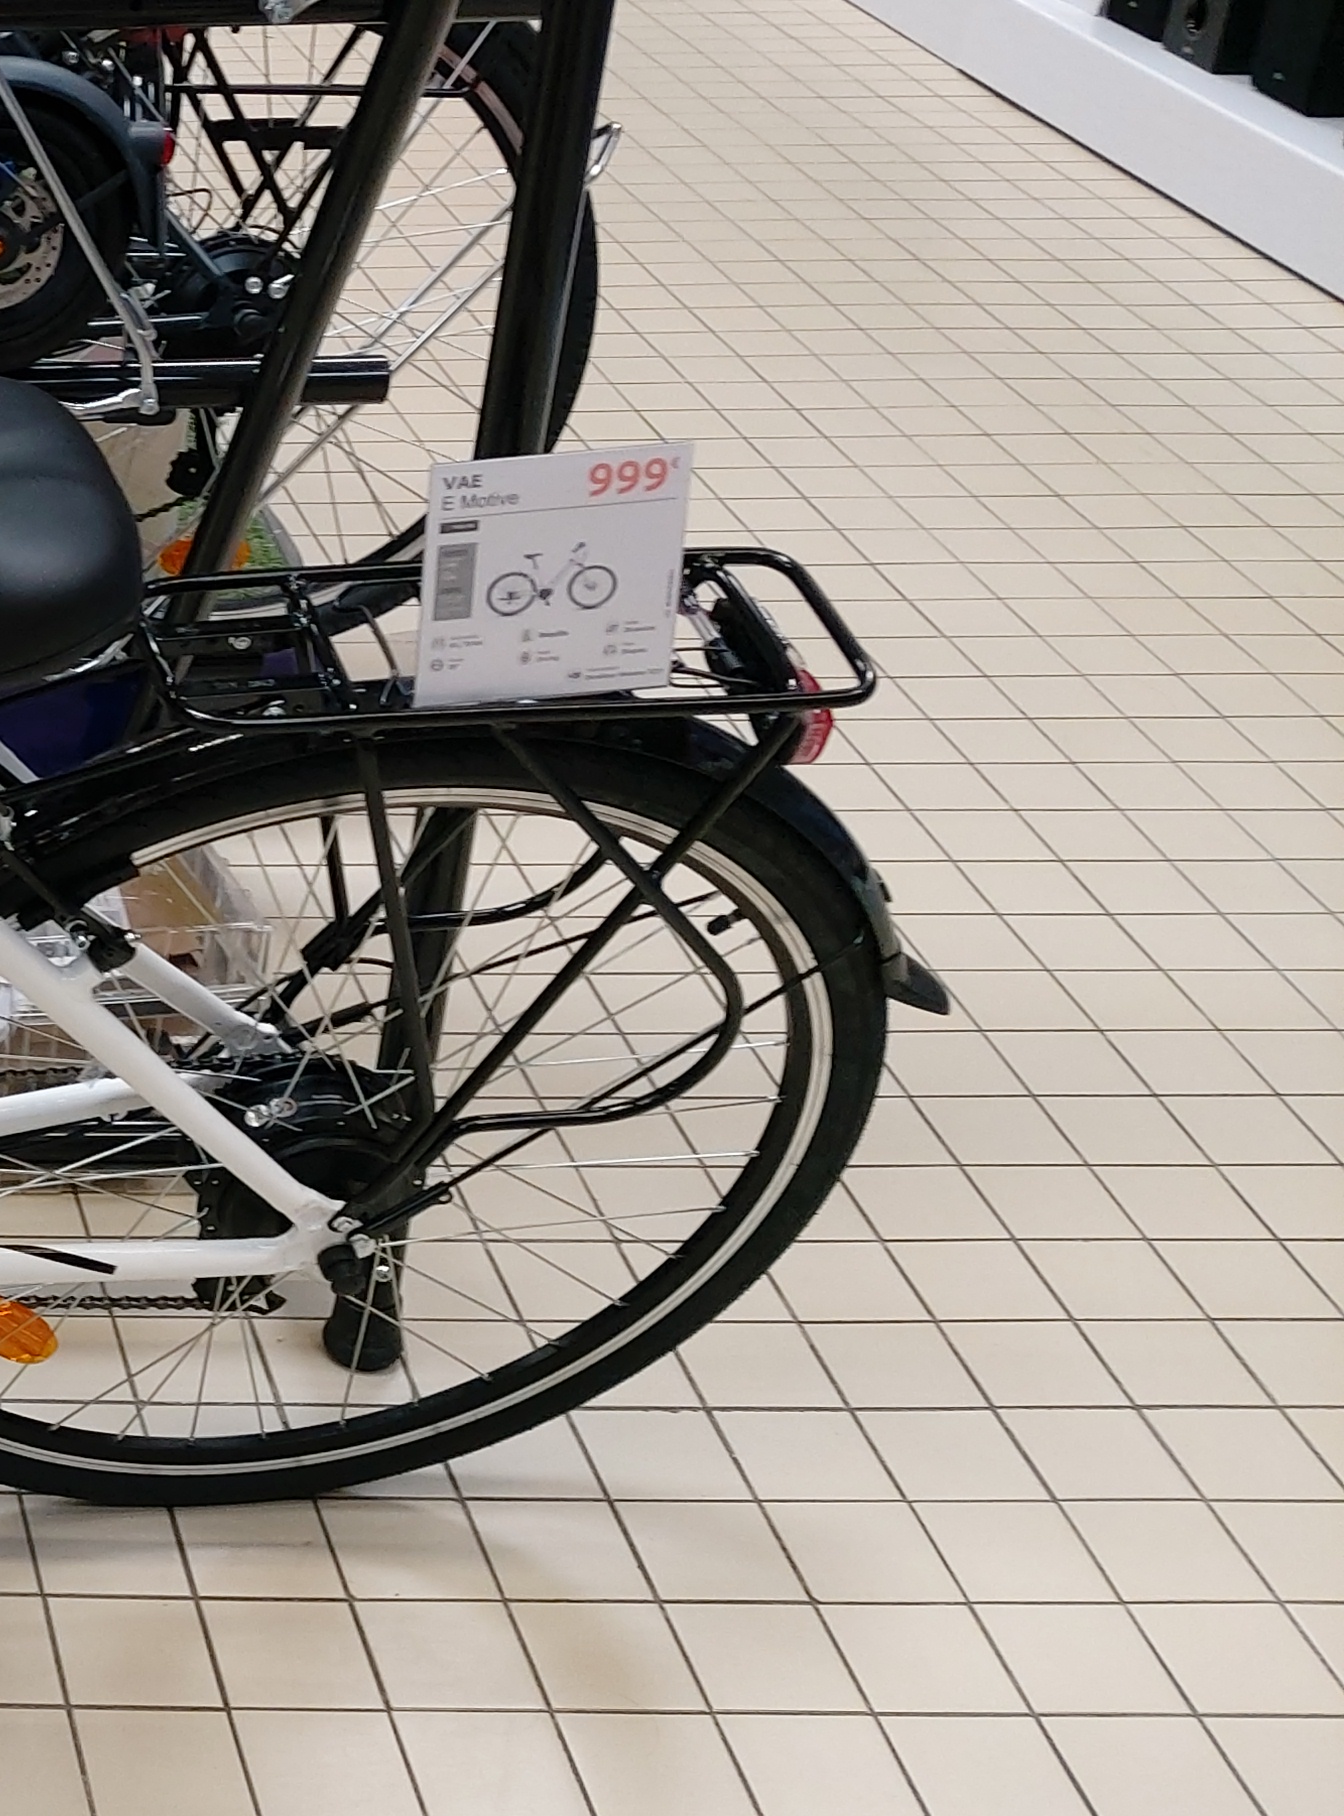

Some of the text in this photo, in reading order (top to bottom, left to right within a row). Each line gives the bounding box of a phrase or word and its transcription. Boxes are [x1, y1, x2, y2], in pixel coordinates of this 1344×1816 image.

[443, 474, 483, 490] VAE
[441, 493, 520, 511] E Motive
